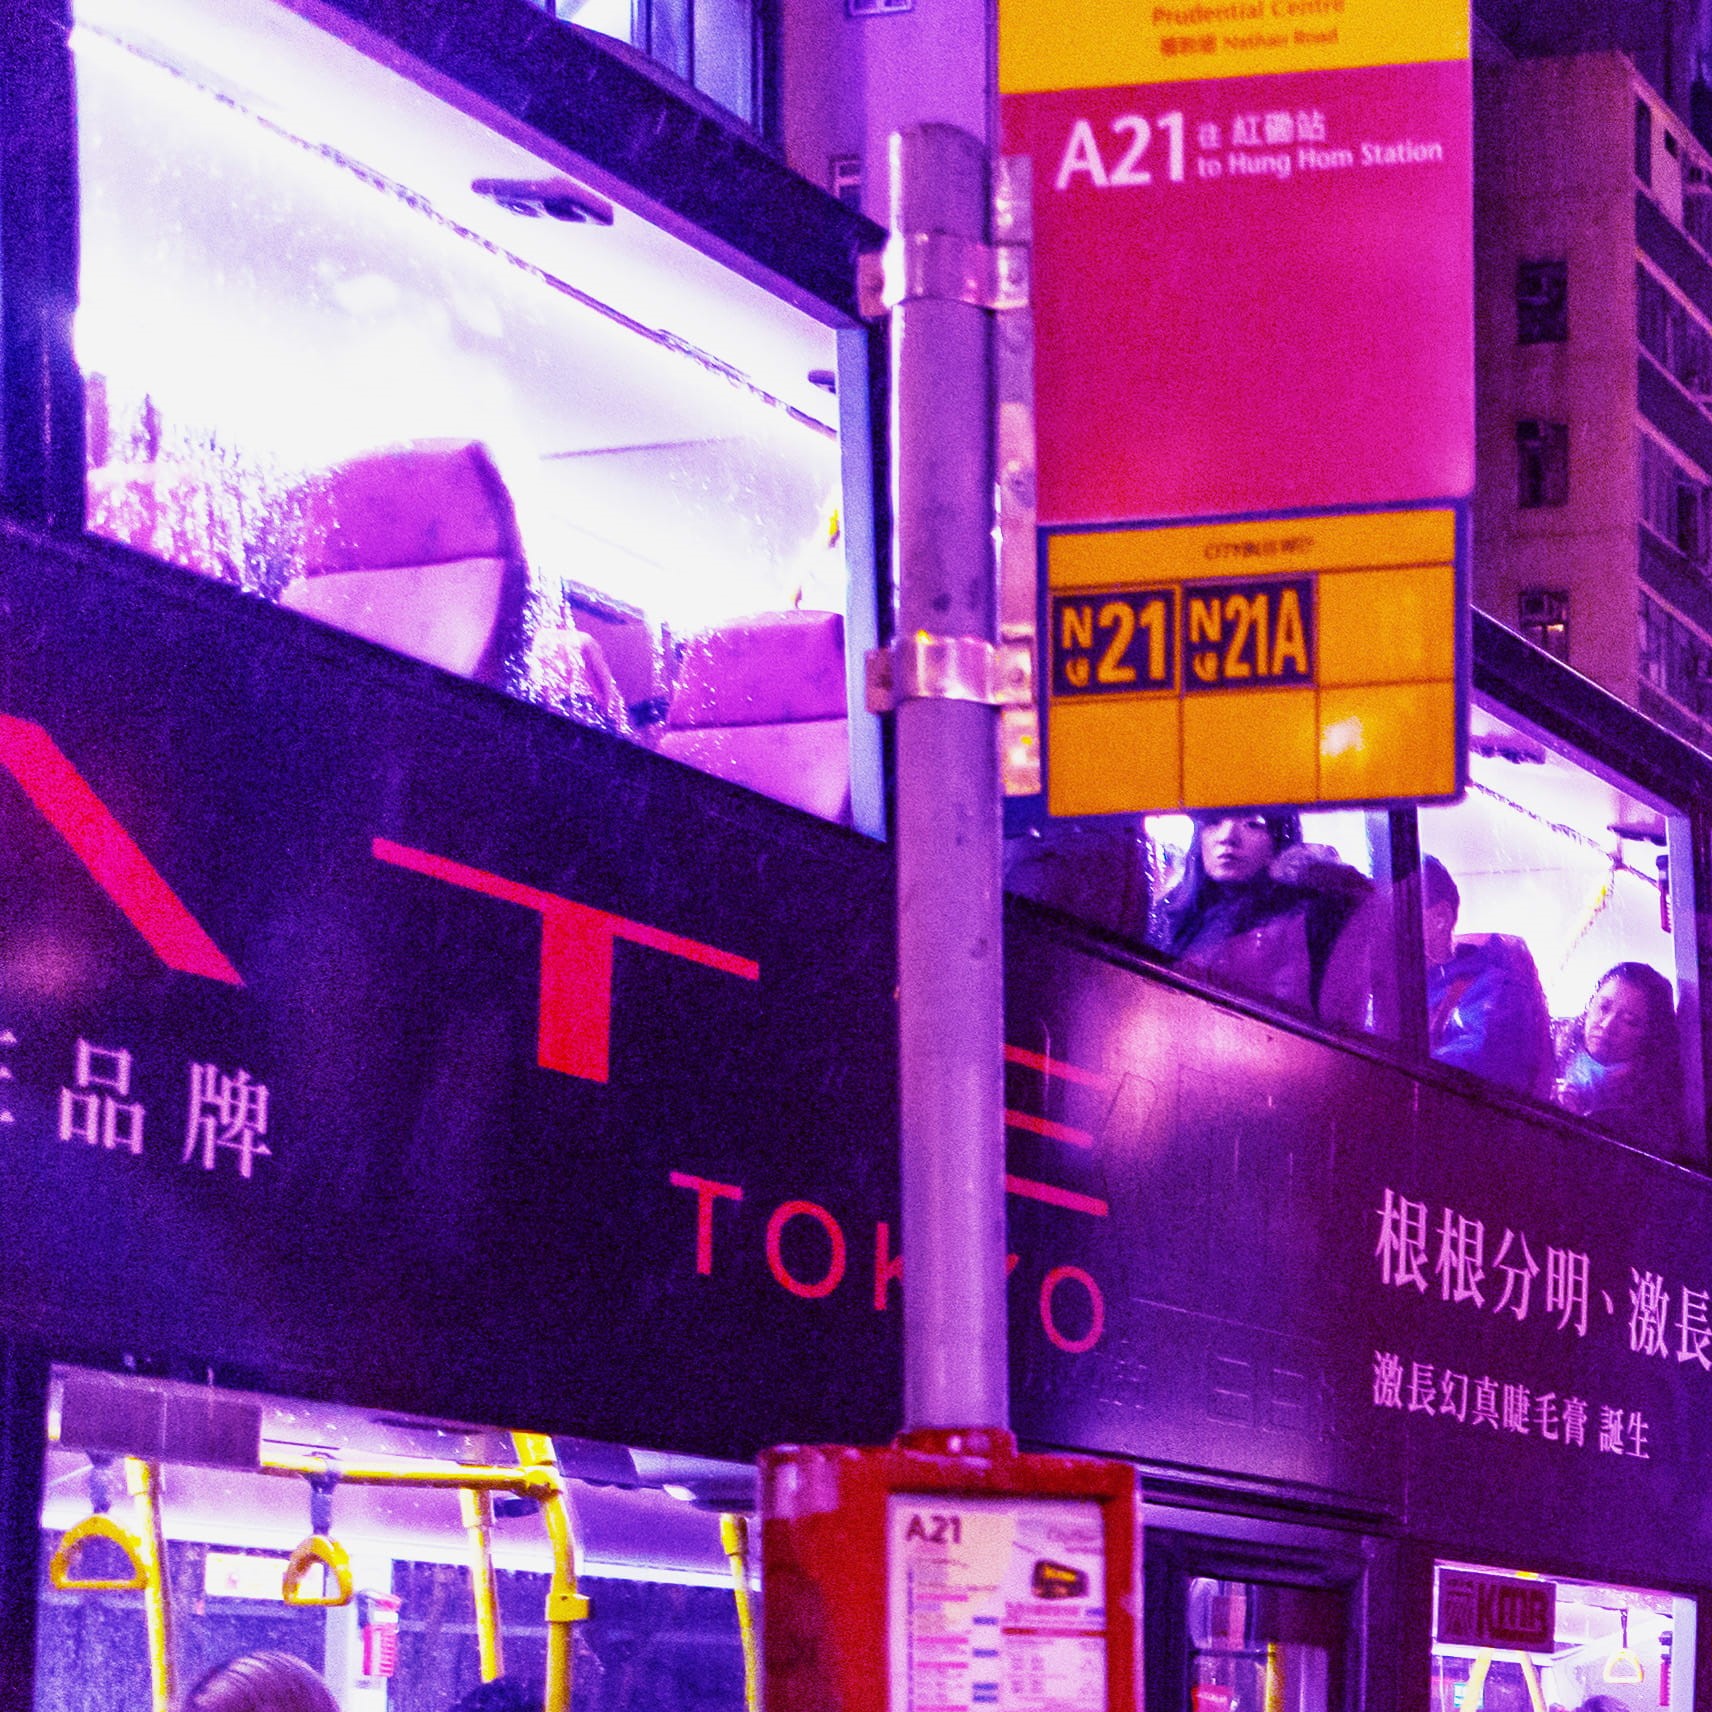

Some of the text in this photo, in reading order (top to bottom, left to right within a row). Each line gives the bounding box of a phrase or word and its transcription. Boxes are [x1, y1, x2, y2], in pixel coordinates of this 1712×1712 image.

[1152, 3, 1264, 26] Prudential
[1055, 110, 1186, 190] A21
[1198, 138, 1444, 179] to Hung Hom Station
[0, 1030, 273, 1179] 品牌
[1599, 1404, 1651, 1460] 誕生
[905, 1513, 962, 1545] A21
[1476, 1582, 1548, 1643] KMB
